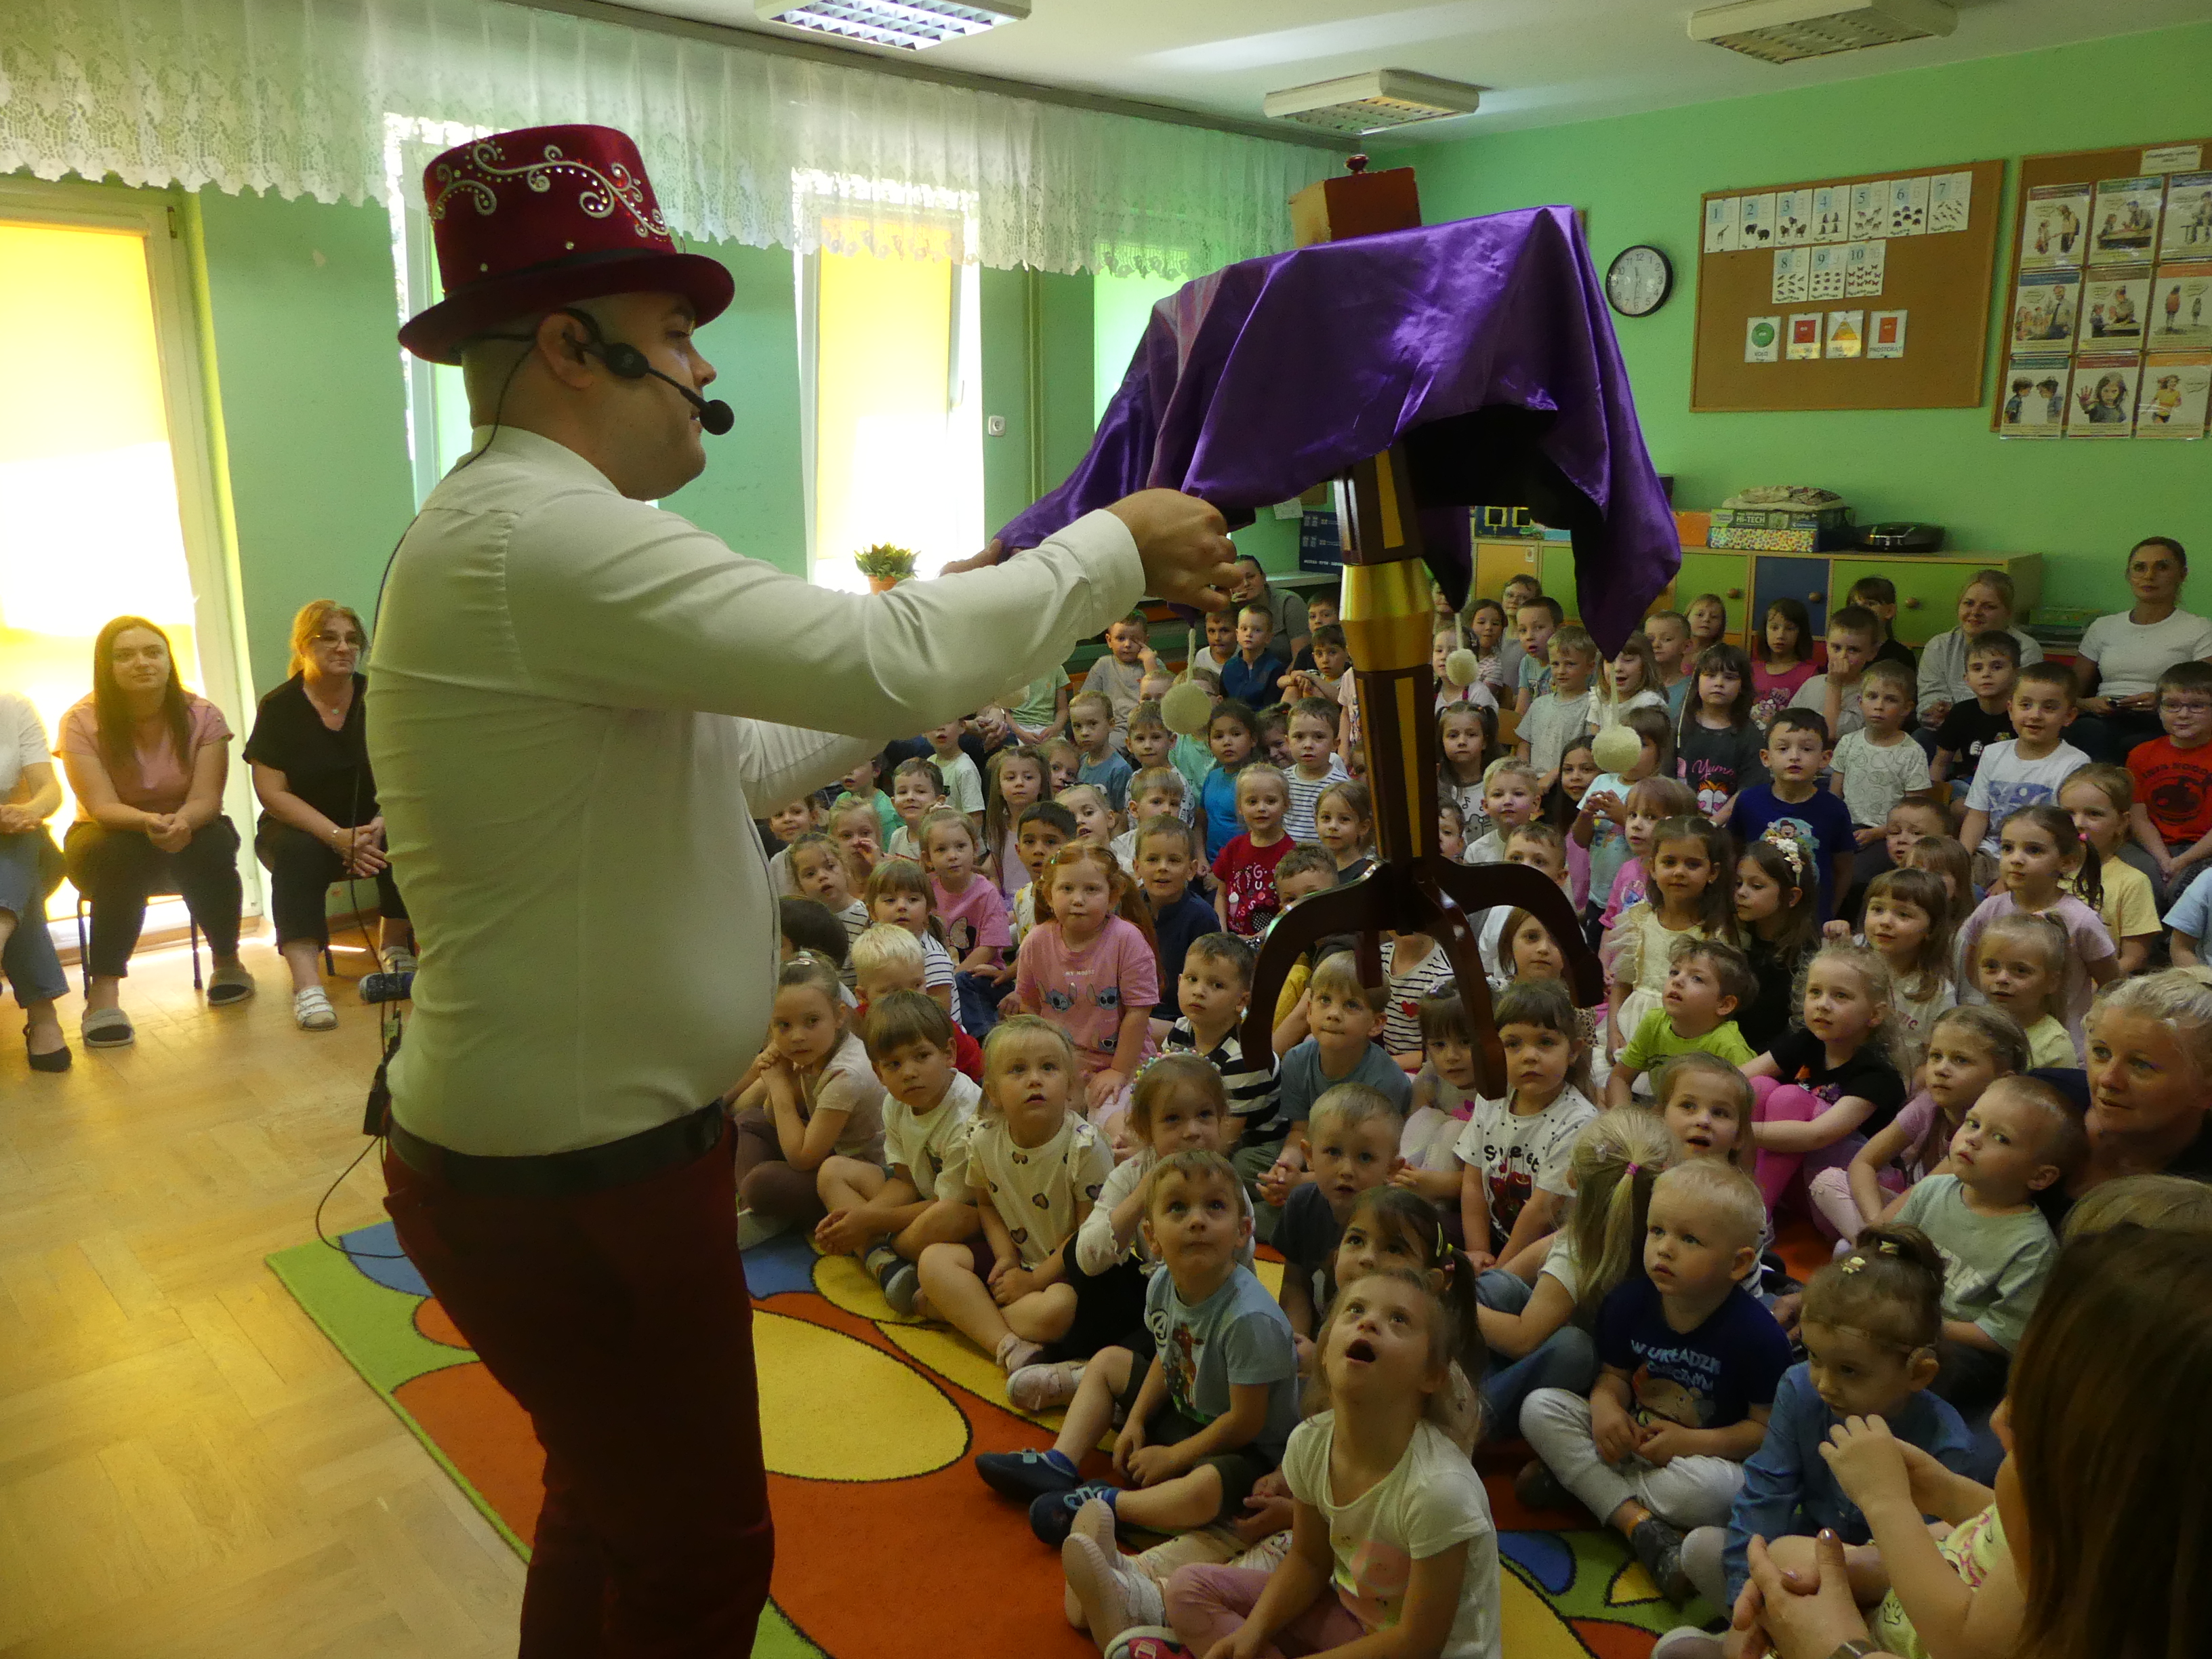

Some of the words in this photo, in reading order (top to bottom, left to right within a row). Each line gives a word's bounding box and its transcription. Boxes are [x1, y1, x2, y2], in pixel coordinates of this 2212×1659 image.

[1938, 183, 1946, 194] 7
[1858, 192, 1865, 203] 5
[1897, 188, 1904, 200] 6
[1783, 201, 1790, 212] 3
[1820, 197, 1827, 207] 4
[1713, 208, 1718, 219] 1
[1746, 204, 1754, 216] 2
[1636, 253, 1645, 262] 12
[1818, 253, 1825, 265] 9
[1851, 249, 1864, 260] 10
[1626, 258, 1633, 266] 11
[1781, 258, 1788, 268] 8
[1655, 263, 1661, 272] 2
[1657, 276, 1663, 285] 3
[1616, 291, 1622, 300] 8
[1624, 298, 1630, 306] 7
[1634, 302, 1639, 310] 6
[1645, 298, 1651, 306] 5
[1631, 1339, 1647, 1354] W
